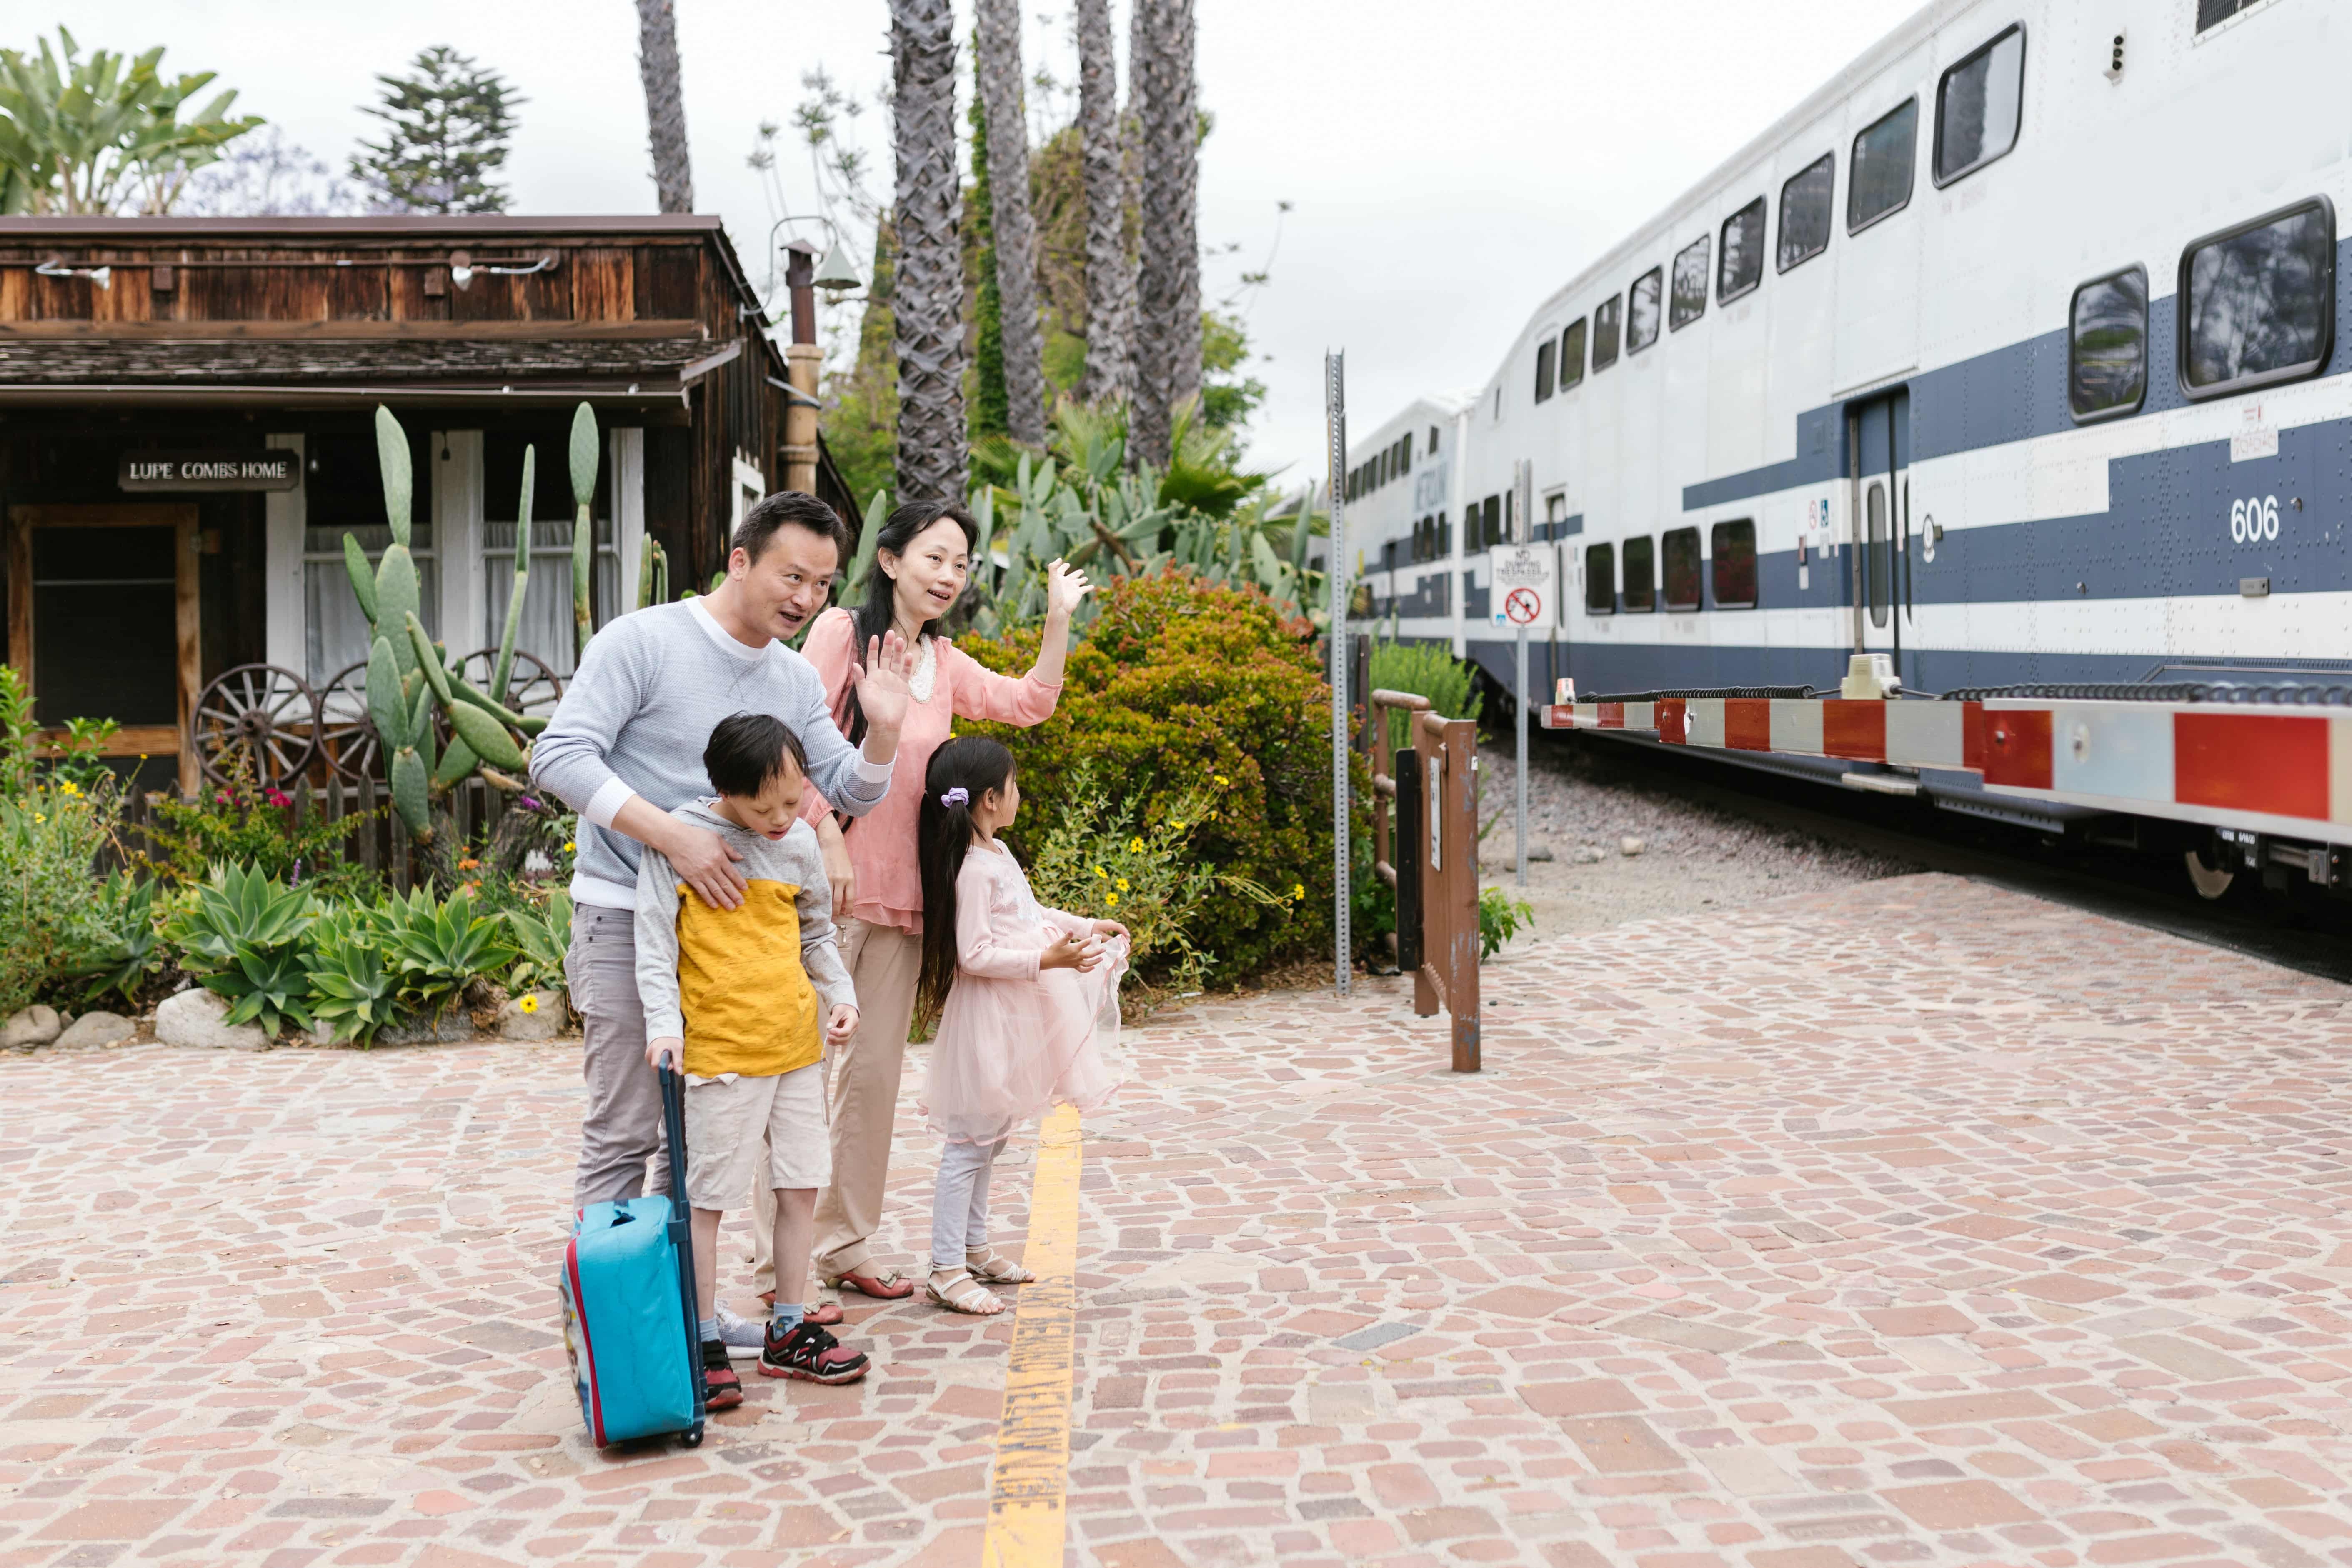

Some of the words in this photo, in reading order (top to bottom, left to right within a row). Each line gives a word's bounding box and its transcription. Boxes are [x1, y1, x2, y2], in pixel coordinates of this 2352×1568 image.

[130, 462, 173, 479] LUPE
[181, 462, 237, 479] COMBS
[242, 461, 287, 478] HOME
[2231, 495, 2279, 544] 606
[1516, 549, 1531, 560] NO
[998, 1379, 1067, 1453] YELLOW
[991, 1458, 1060, 1513] LINE
